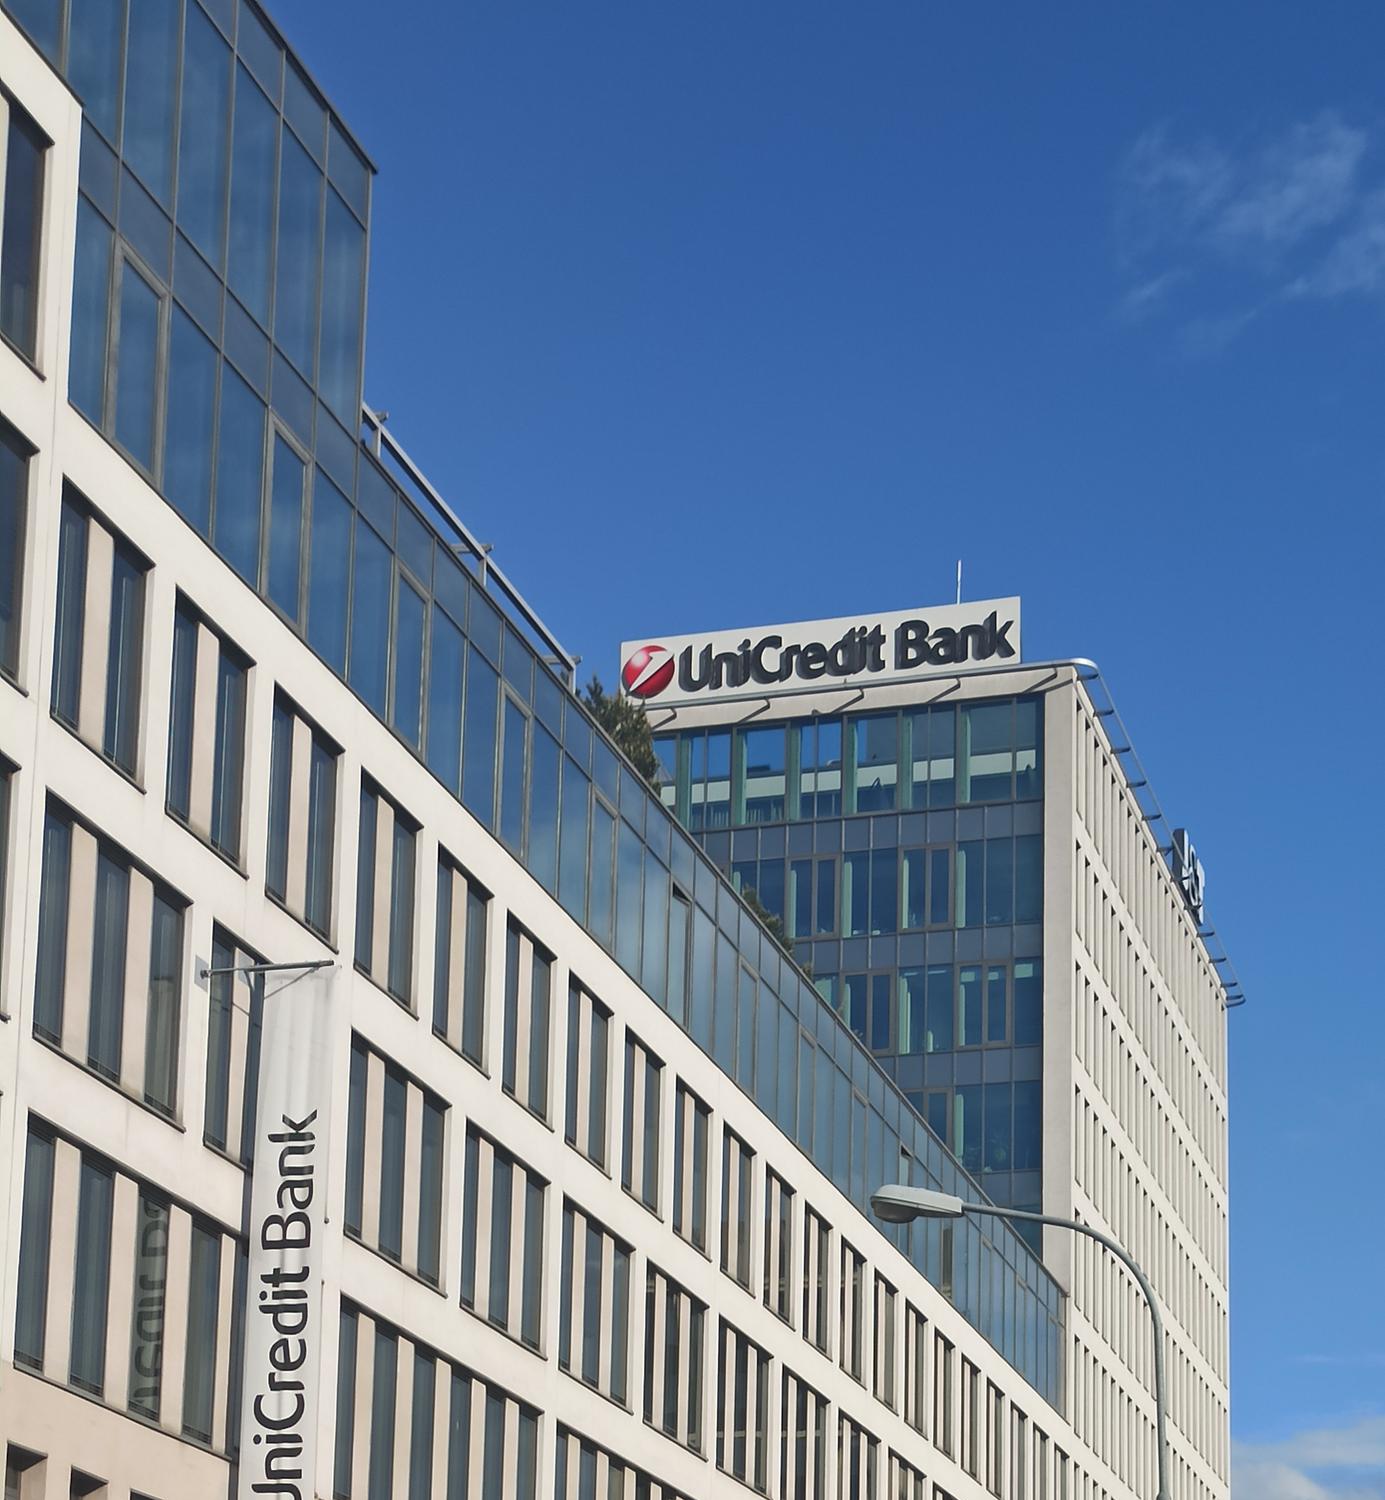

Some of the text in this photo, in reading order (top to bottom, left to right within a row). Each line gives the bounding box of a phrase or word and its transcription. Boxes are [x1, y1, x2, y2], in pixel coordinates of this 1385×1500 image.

[678, 610, 1016, 692] UniCredit Bank
[260, 1108, 318, 1251] Bank
